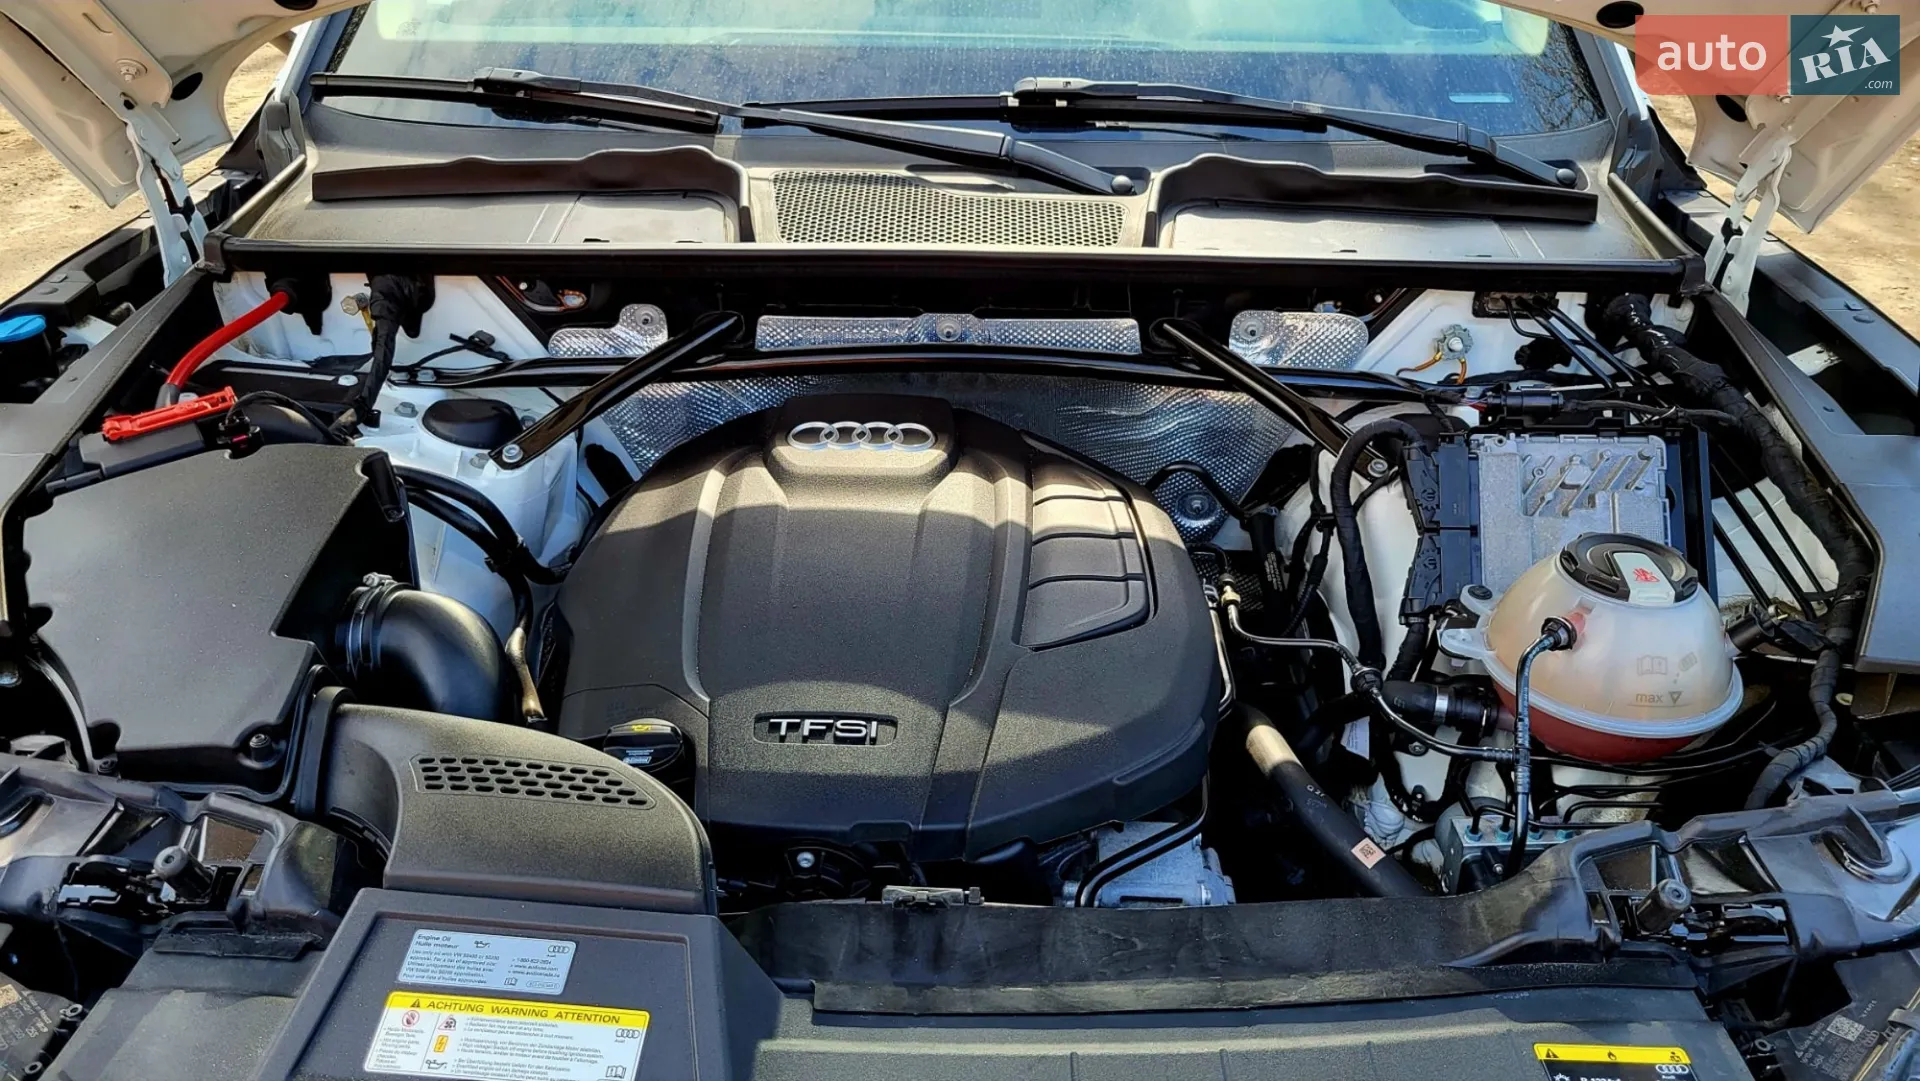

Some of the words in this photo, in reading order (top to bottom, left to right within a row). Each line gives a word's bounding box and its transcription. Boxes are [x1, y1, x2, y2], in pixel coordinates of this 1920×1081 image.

[1635, 693, 1664, 704] max
[769, 718, 878, 738] TFSI
[427, 1001, 484, 1012] ACHTUNG
[491, 1006, 549, 1017] WARNING
[554, 1011, 621, 1024] ATTENTION
